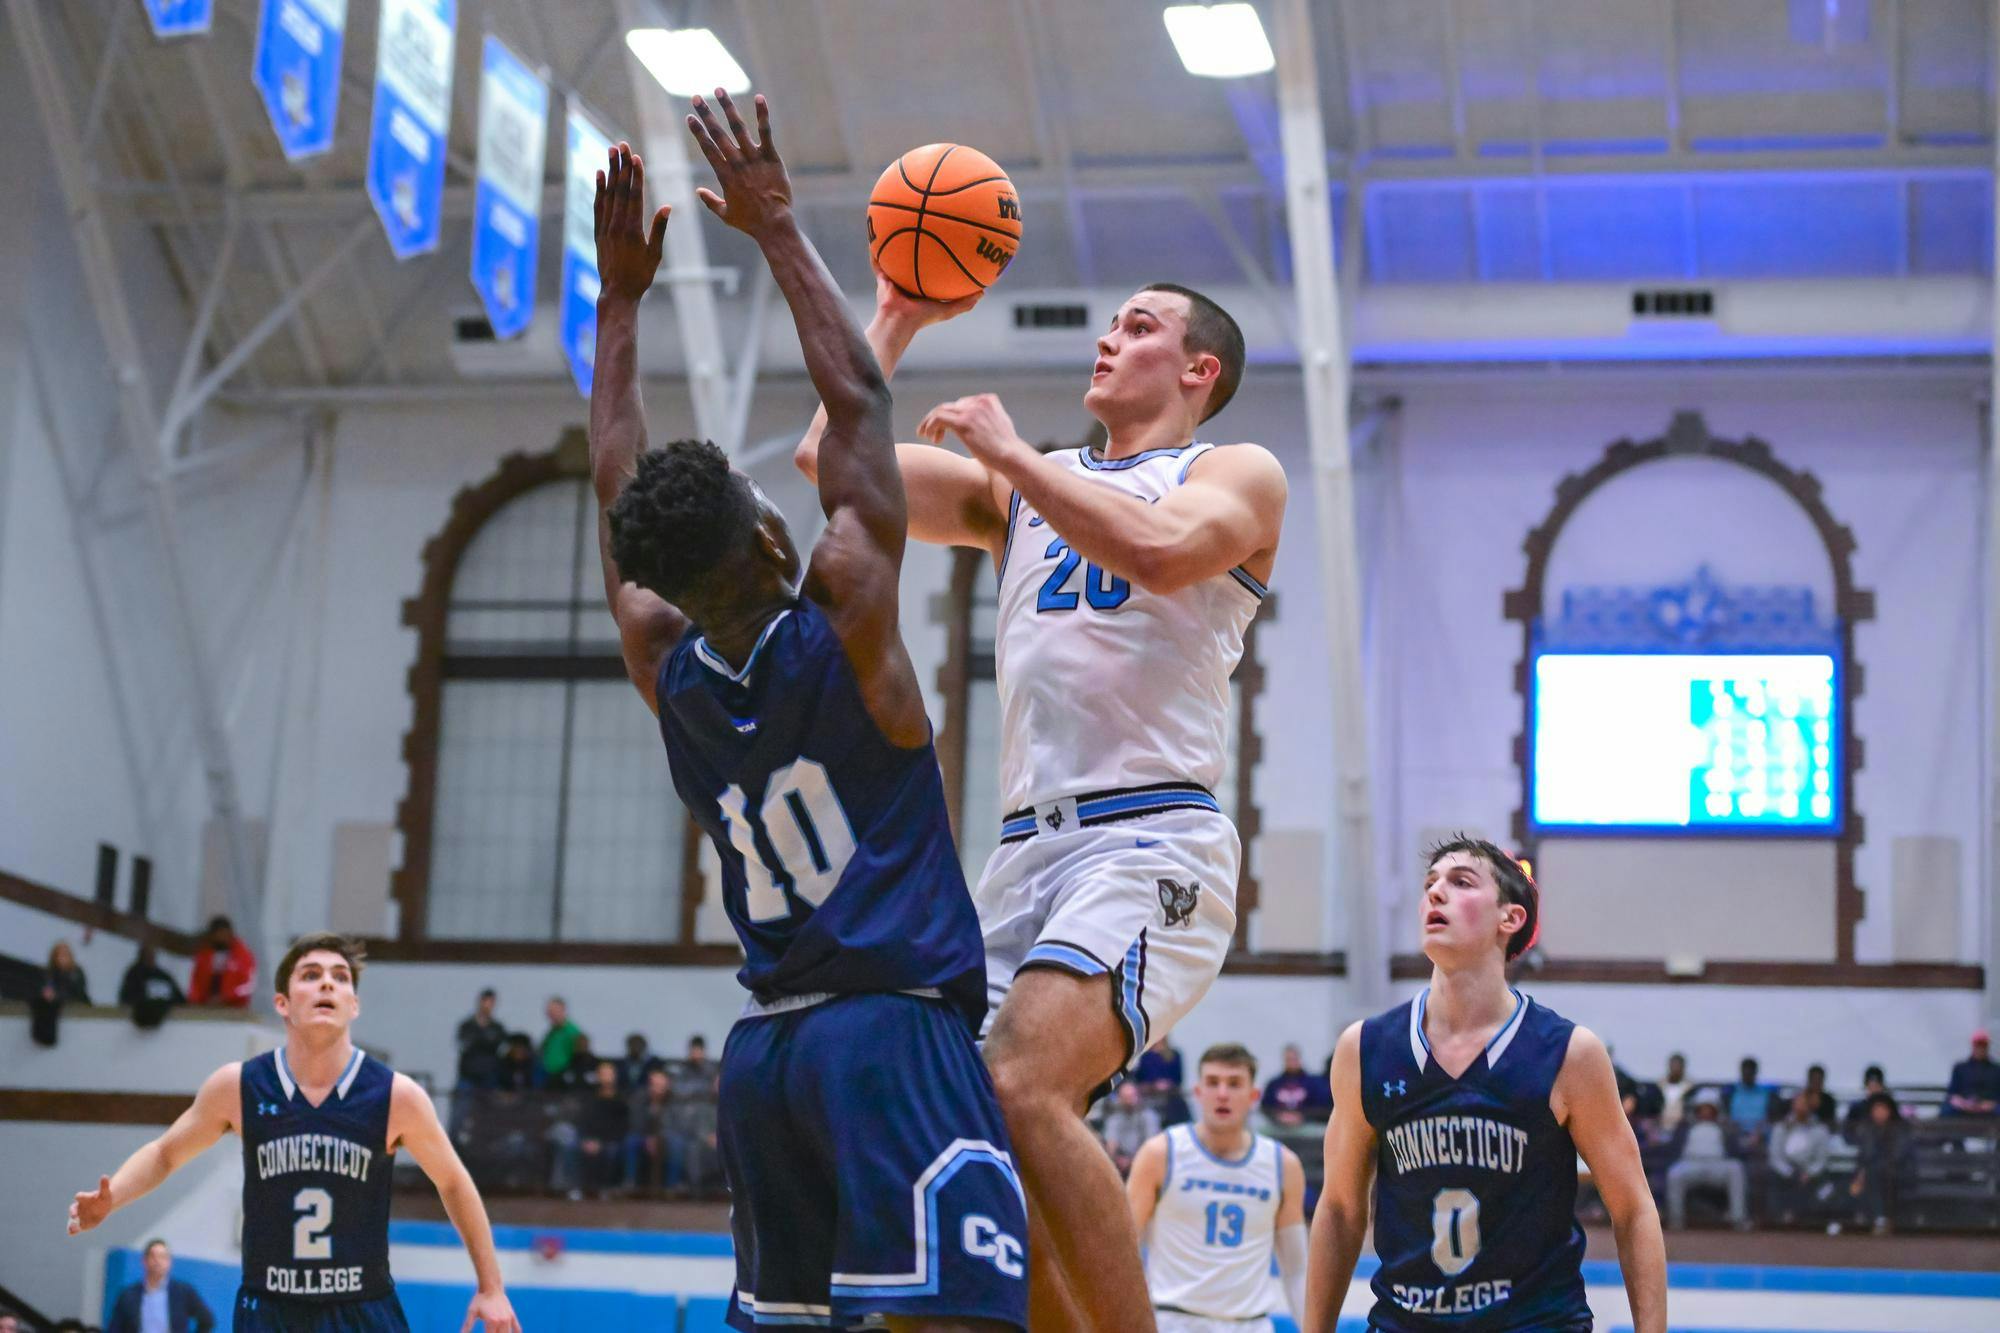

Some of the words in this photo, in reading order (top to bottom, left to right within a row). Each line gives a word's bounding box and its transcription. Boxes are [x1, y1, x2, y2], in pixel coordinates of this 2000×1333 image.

[716, 755, 859, 924] 10
[257, 1134, 372, 1182] CONNECTICUT
[1386, 1116, 1528, 1175] CONNECTICUT
[293, 1187, 333, 1259] 2
[961, 1214, 1024, 1279] CC
[1205, 1201, 1246, 1247] 13
[1431, 1187, 1481, 1276] 0
[266, 1266, 363, 1294] COLLEGE
